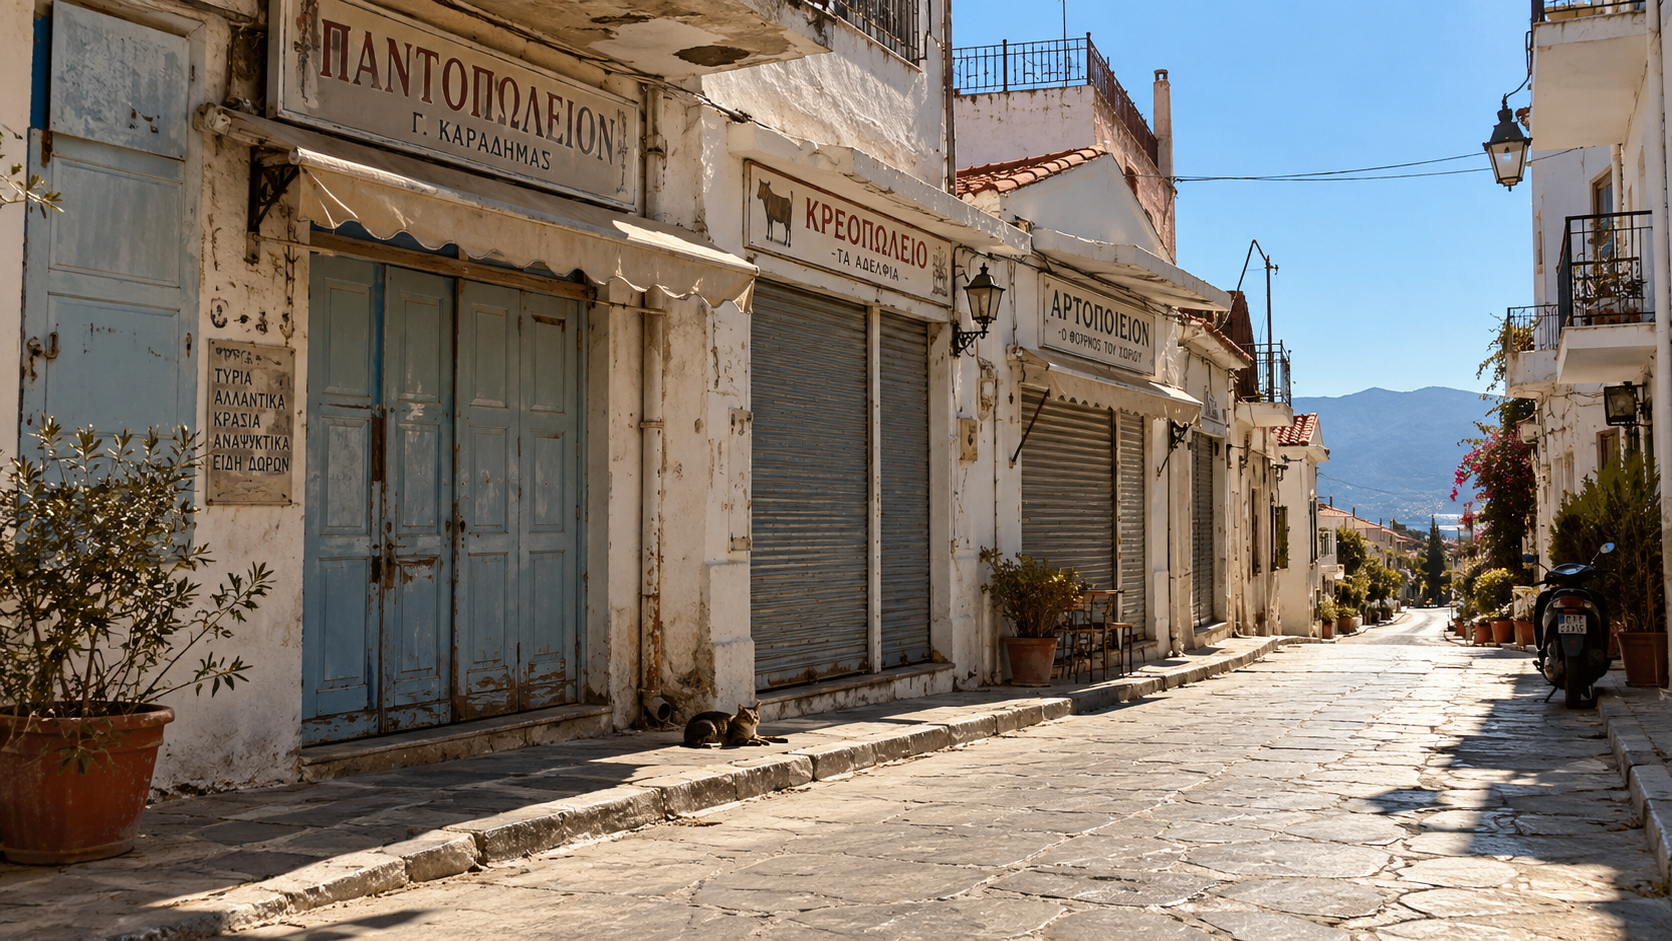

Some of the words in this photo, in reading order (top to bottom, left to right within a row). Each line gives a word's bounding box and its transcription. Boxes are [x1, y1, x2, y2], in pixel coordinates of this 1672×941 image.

[320, 18, 615, 165] ΠΑΝΤΟΠΩΛΕΙΟΝ
[411, 111, 428, 136] Γ.
[438, 119, 552, 171] ΚΑΡΑΔΗΜΑΣ
[805, 197, 928, 269] ΚΡΕΟΠΩΛΕΙΟ
[855, 255, 899, 281] ΑΔΕΛΦΙΑ
[1051, 289, 1150, 348] ΑΡΤΟΠΟΙΕΙΟΝ
[215, 368, 252, 386] ΤΥΡΙΑ
[214, 390, 286, 410] ΑΛΛΑΝΤΙΚΑ
[214, 411, 261, 428] ΚΡΑΣΙΑ
[213, 433, 290, 450] ΑΝΑΨΥΚΤΙΚΑ
[213, 454, 242, 471] ΕΙΔΗ
[248, 456, 290, 472] ΔΩΡΩΝ
